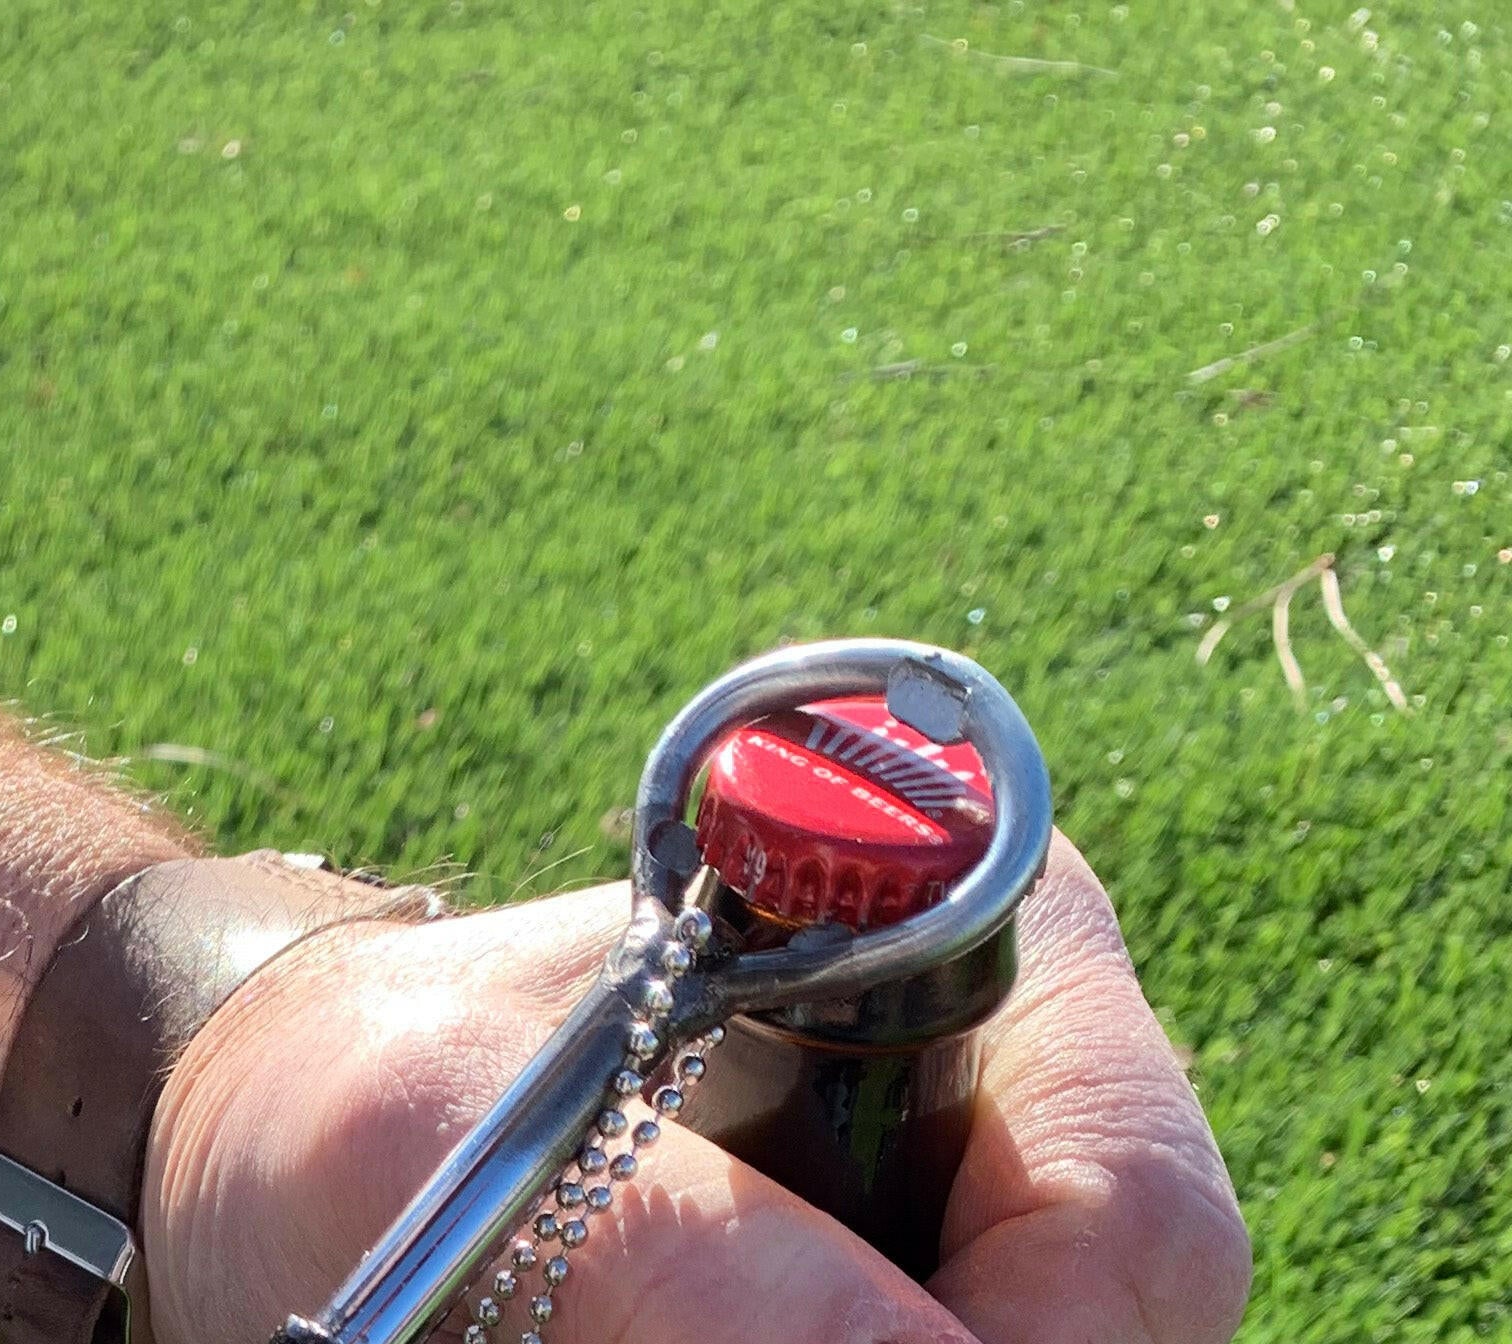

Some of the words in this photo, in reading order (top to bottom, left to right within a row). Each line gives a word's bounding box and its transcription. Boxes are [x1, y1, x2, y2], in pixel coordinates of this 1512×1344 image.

[746, 735, 809, 768] KING
[812, 764, 849, 787] OF
[851, 787, 934, 837] BEERS
